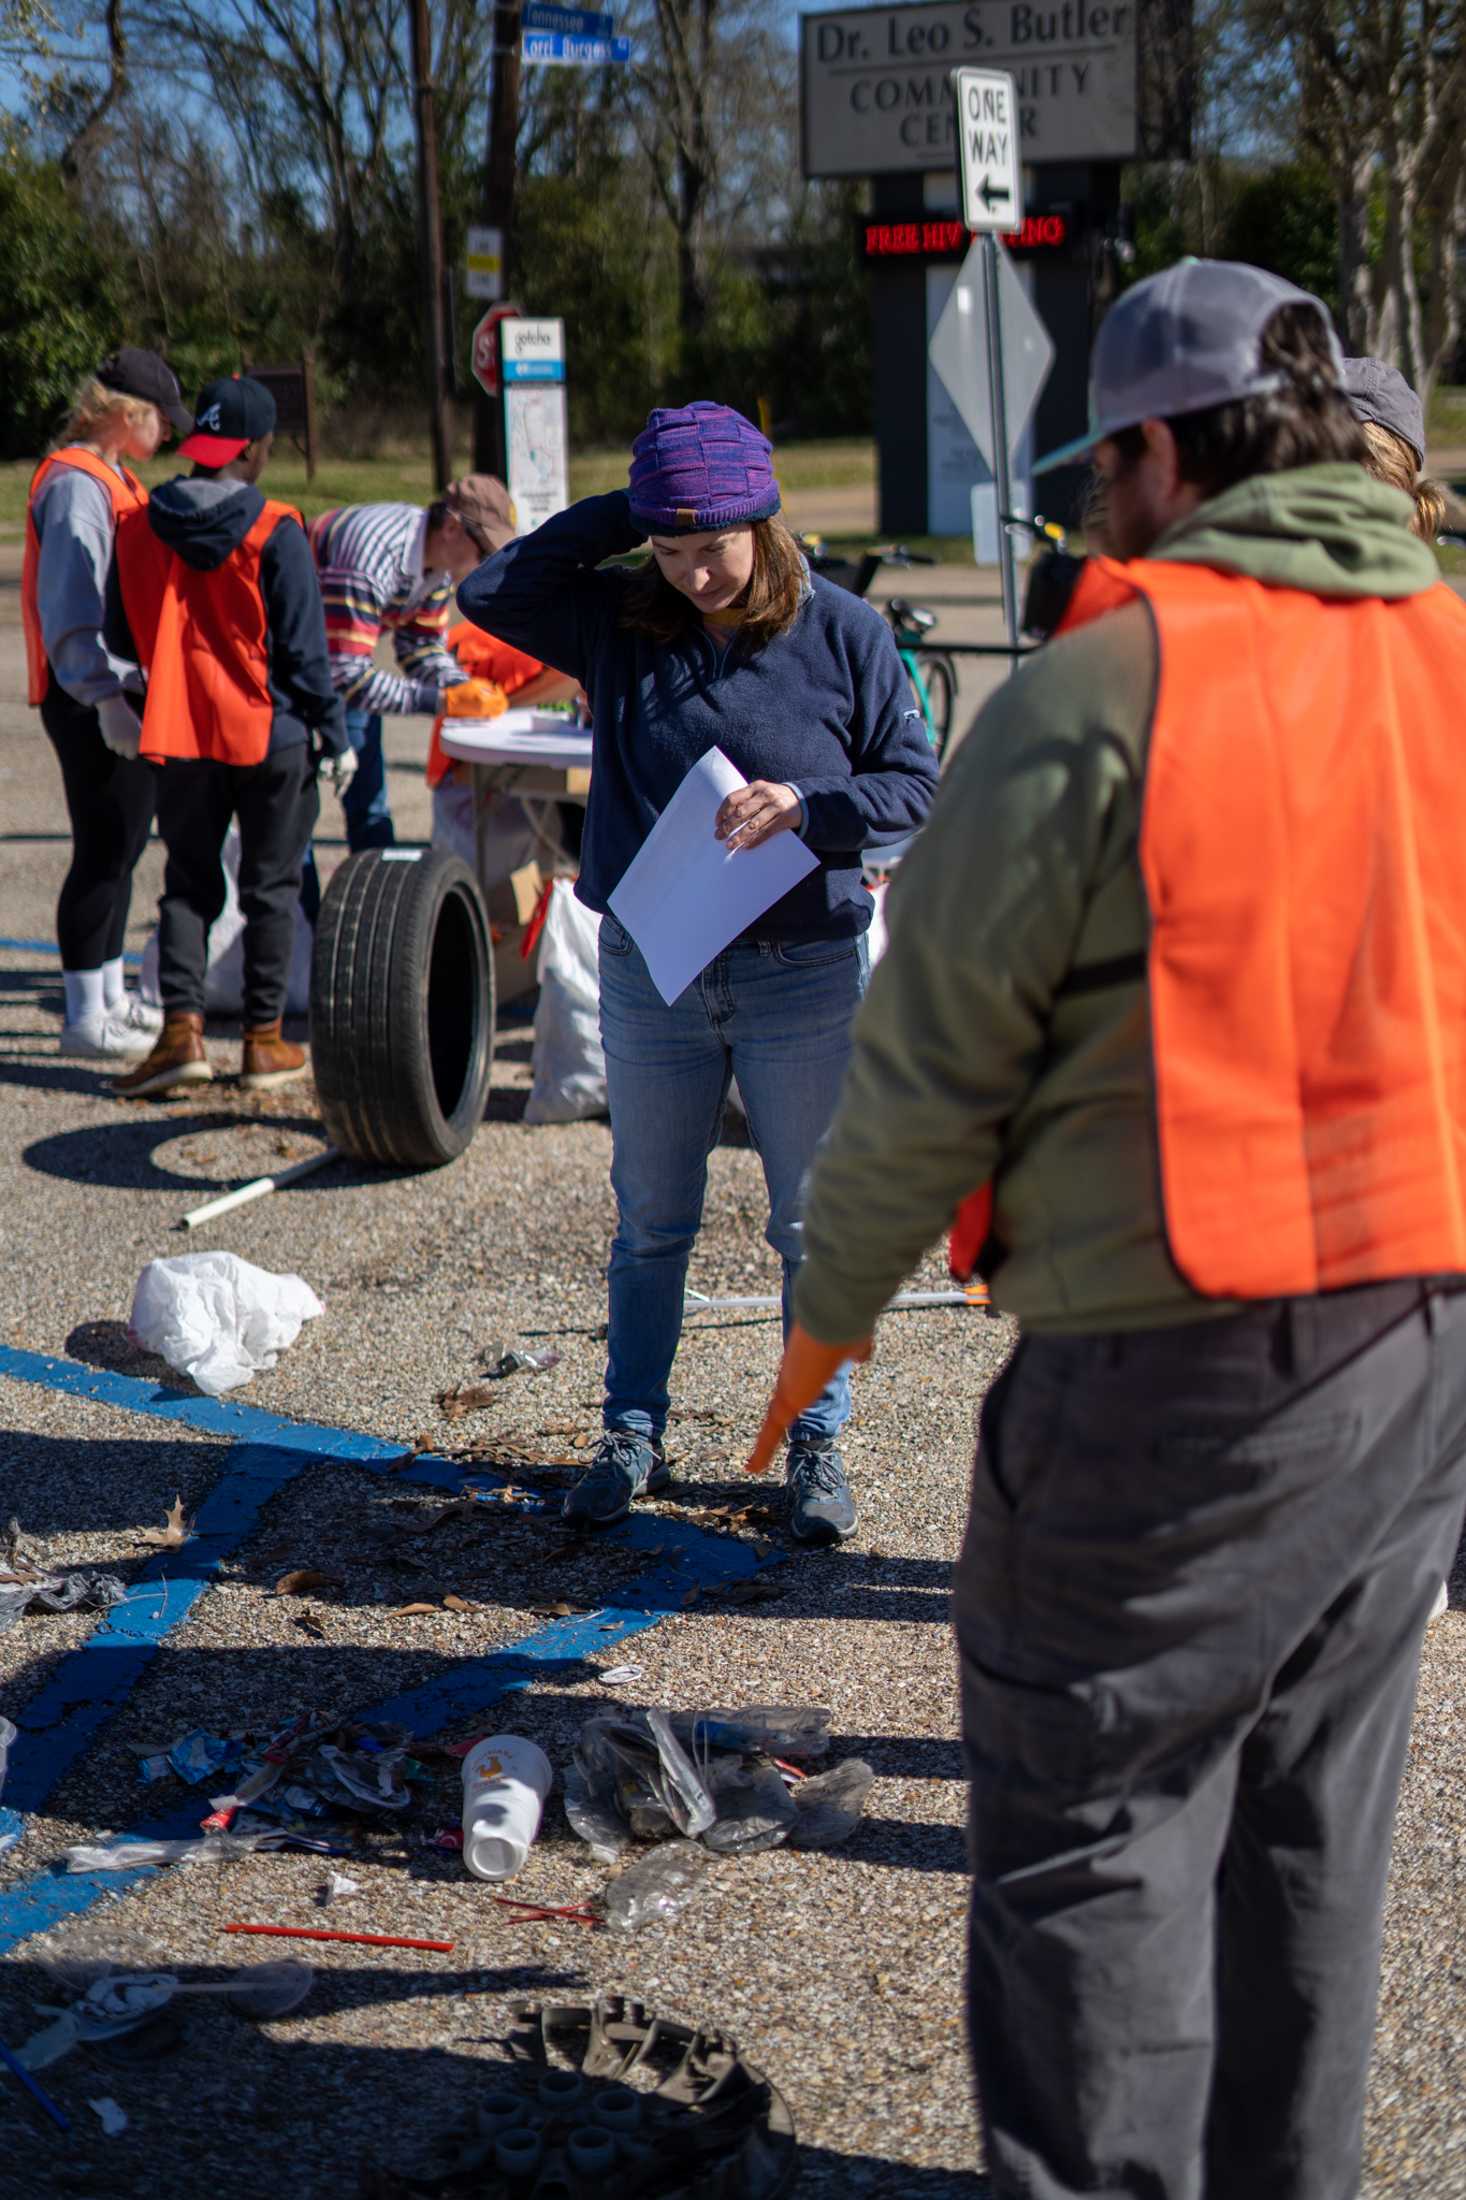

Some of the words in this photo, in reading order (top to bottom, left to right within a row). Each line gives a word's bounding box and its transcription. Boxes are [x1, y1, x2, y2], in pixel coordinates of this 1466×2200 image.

[816, 23, 870, 62] Dr.
[887, 15, 950, 56] Leo
[962, 6, 996, 49] S.
[1010, 0, 1128, 45] Butler
[850, 63, 1090, 113] COMMNITY
[968, 85, 1008, 125] ONE
[968, 128, 1009, 168] WAY
[514, 322, 552, 356] gotcha
